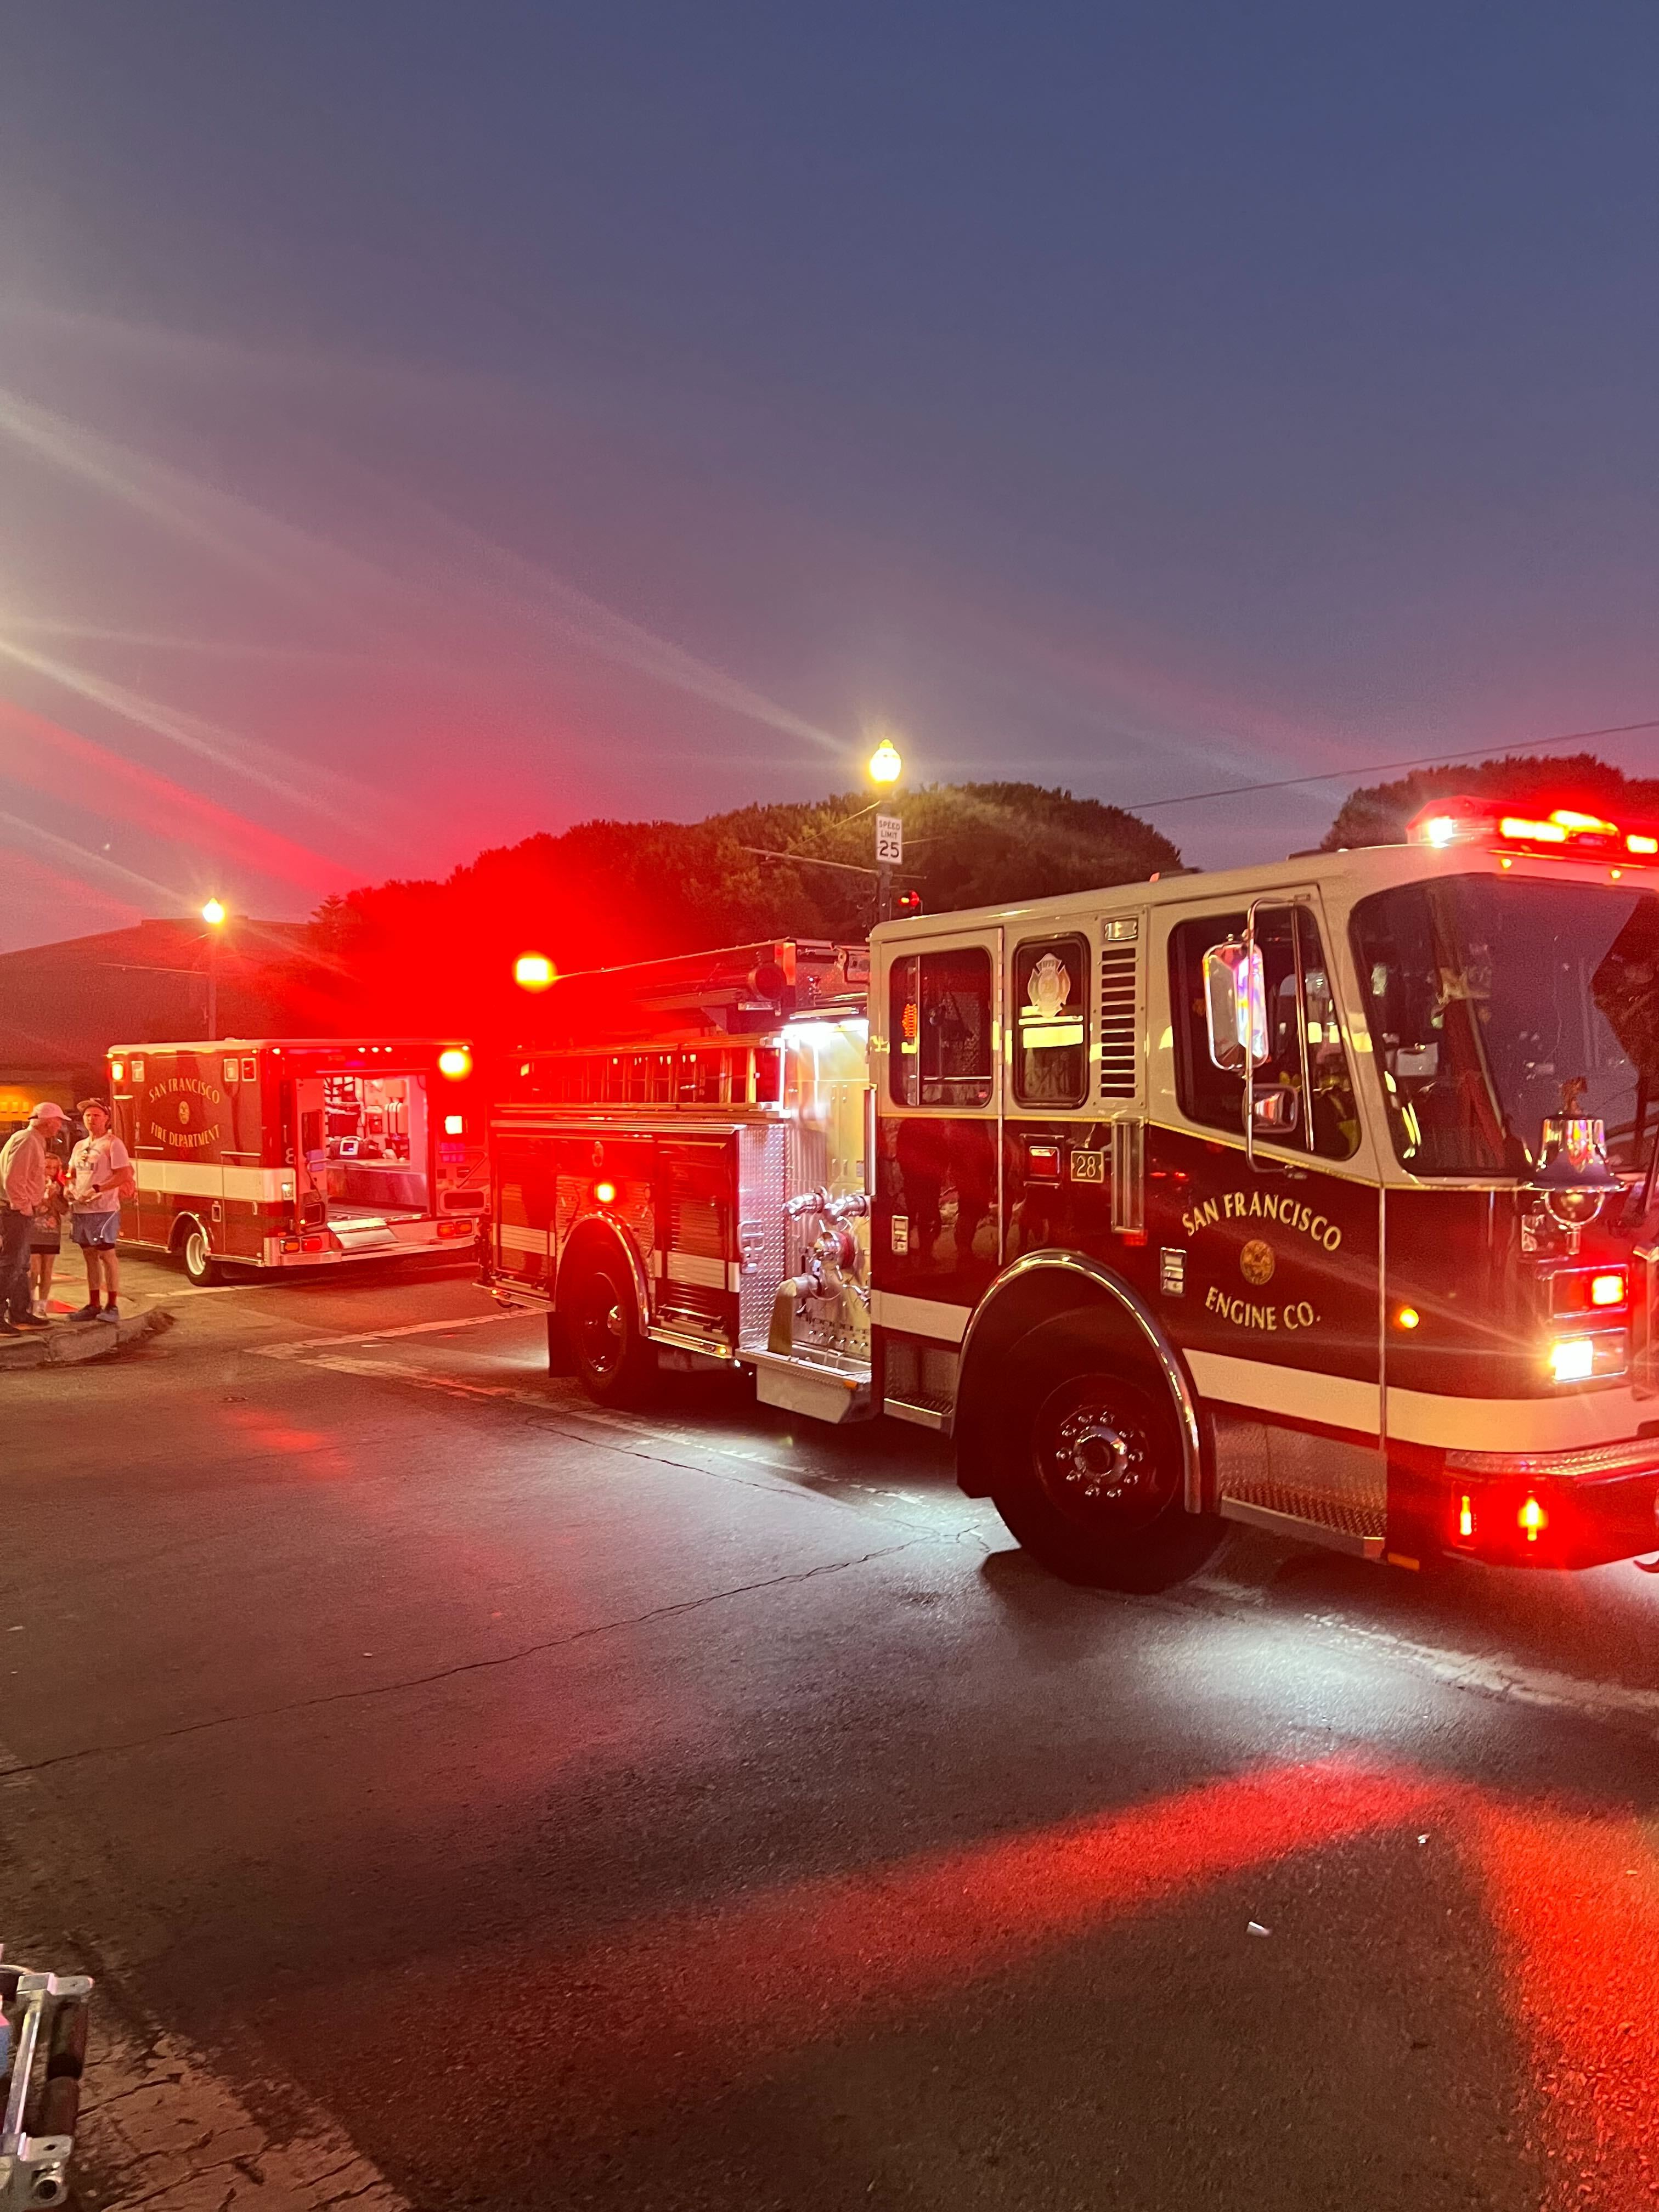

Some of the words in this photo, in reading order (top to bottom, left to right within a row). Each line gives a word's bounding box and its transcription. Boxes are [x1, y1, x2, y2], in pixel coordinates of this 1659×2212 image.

[879, 820, 900, 830] SPEED
[881, 829, 898, 839] LIMIT
[879, 840, 899, 858] 25
[149, 1083, 167, 1103] SAN
[168, 1078, 219, 1104] FRANCISCO
[151, 1122, 167, 1142] FIRE
[169, 1124, 219, 1147] DEPARTMENT
[1076, 1155, 1096, 1178] 28
[1182, 1198, 1219, 1237] SAN
[1223, 1191, 1342, 1251] FRANCISCO
[1205, 1286, 1277, 1330] ENGINE
[1283, 1301, 1321, 1330] CO.
